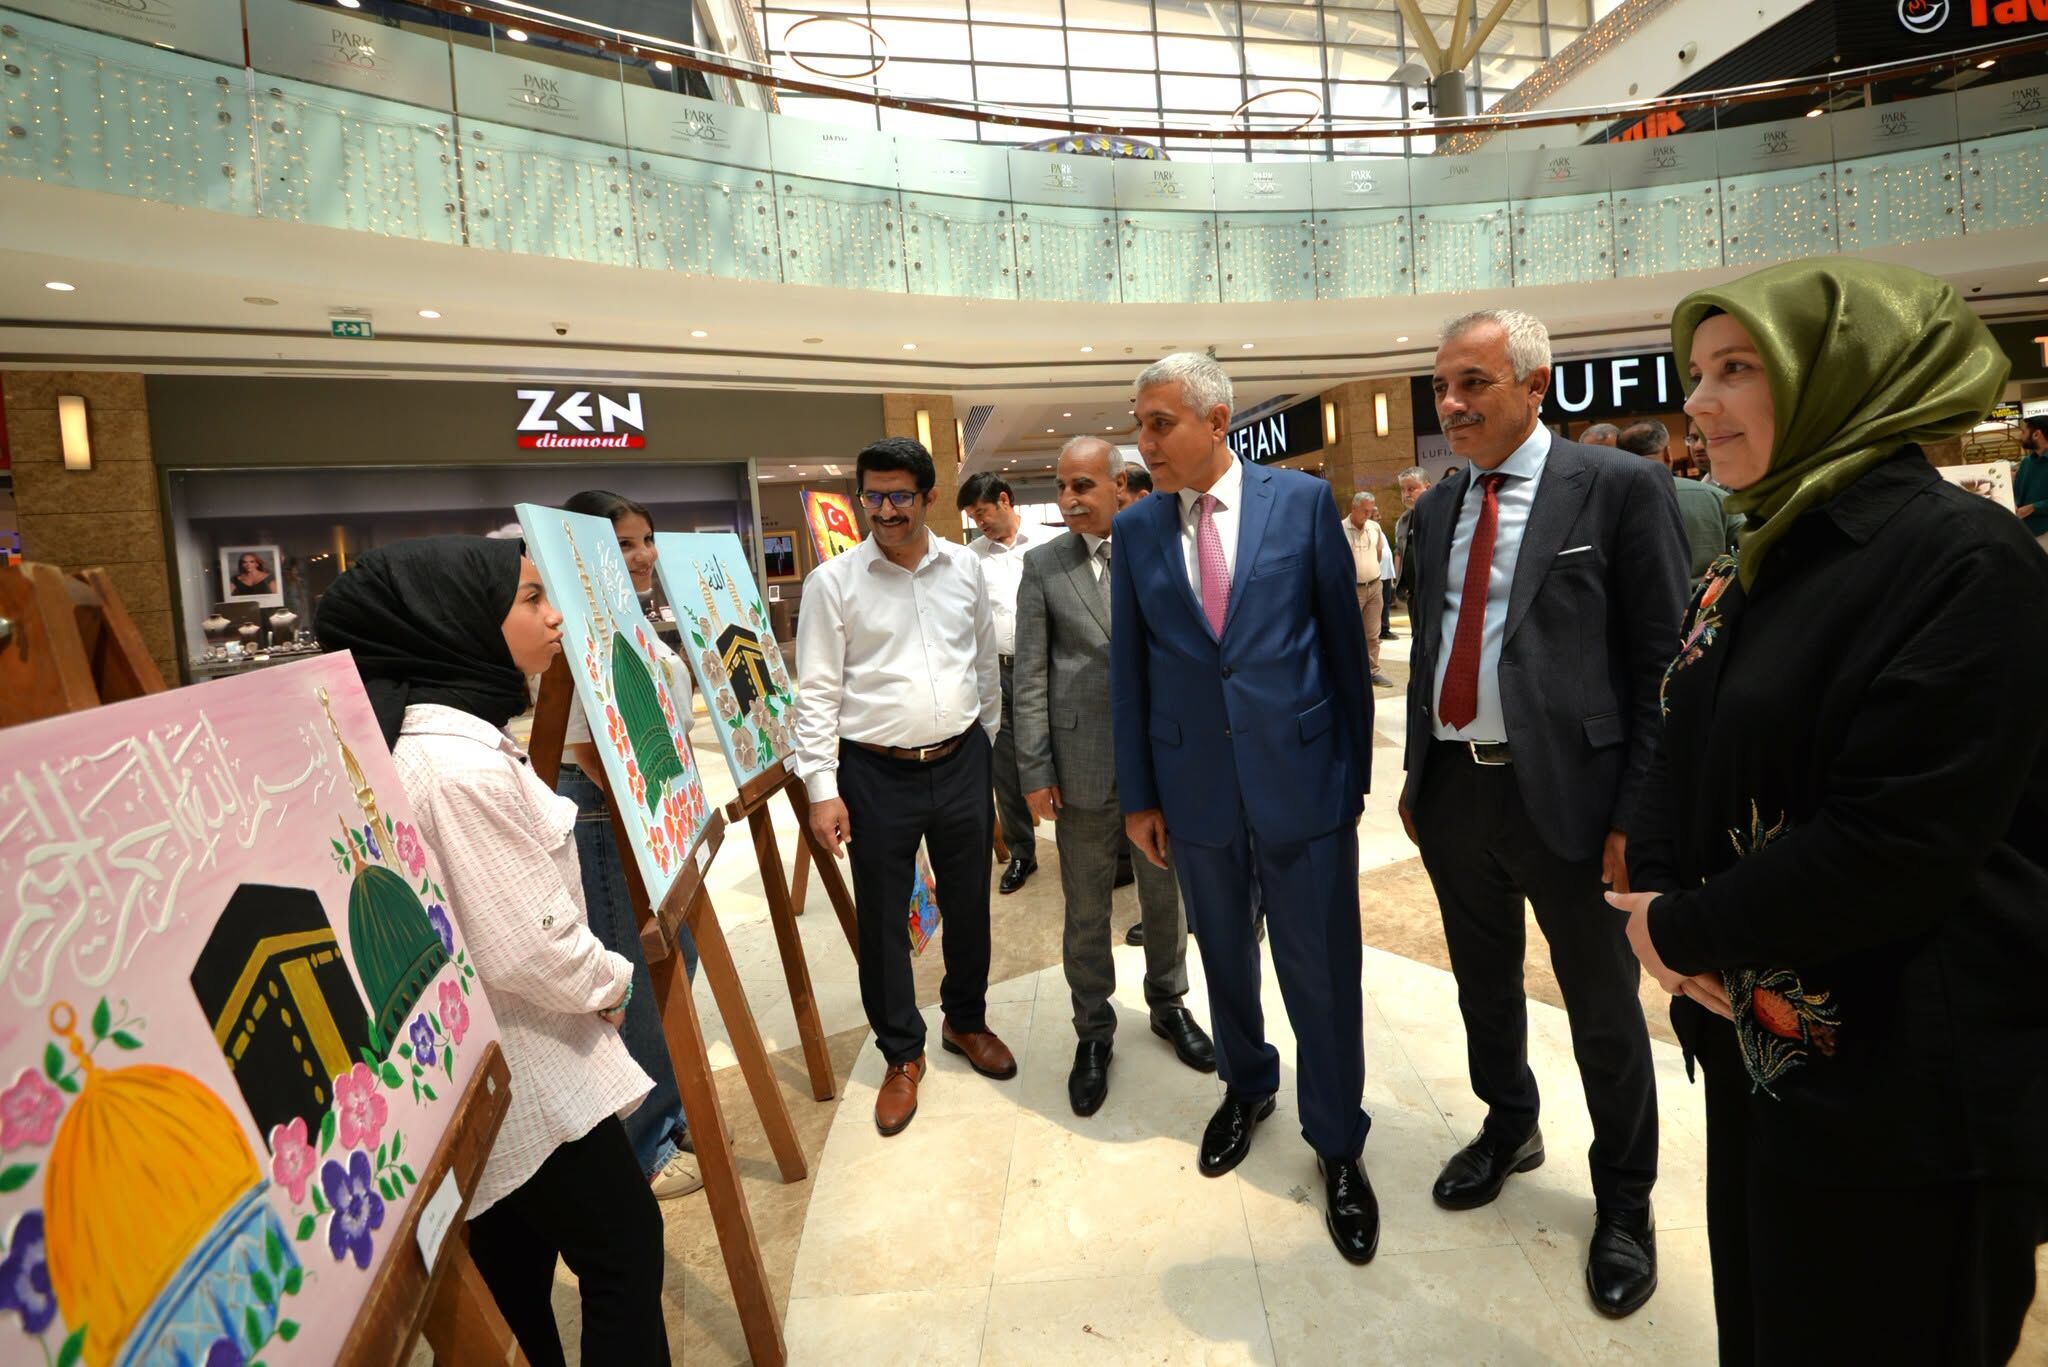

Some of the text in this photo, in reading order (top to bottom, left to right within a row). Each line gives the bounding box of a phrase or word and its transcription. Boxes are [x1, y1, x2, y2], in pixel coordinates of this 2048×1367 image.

[332, 29, 372, 47] PARK
[523, 73, 559, 94] PARK
[2011, 87, 2041, 99] PARK
[684, 109, 714, 125] PARK
[1881, 111, 1907, 123] PARK
[1763, 130, 1788, 142] PARK
[1652, 145, 1676, 156] PARK
[1351, 169, 1372, 180] PARK
[1554, 355, 1668, 412] UFI
[516, 389, 645, 432] ZEN
[535, 433, 630, 448] diamond
[1226, 413, 1287, 461] UFIAN
